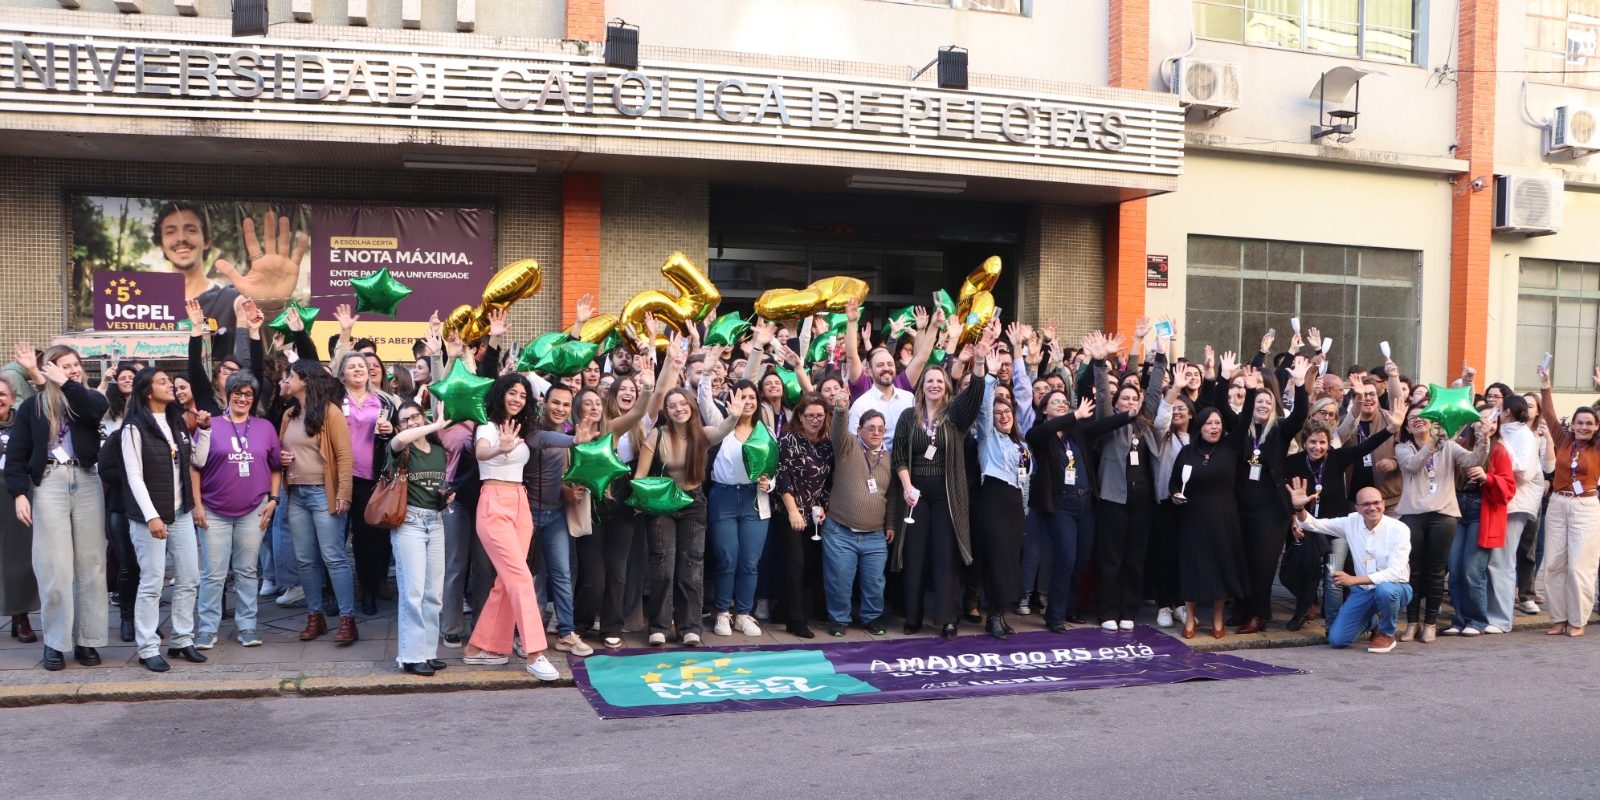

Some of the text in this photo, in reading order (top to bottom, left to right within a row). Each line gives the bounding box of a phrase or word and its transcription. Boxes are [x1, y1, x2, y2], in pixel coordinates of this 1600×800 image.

[811, 85, 881, 130] DE
[901, 92, 1127, 152] PELOTAS
[344, 250, 393, 263] NOTA
[395, 248, 474, 265] MÁXIMA.
[406, 271, 469, 279] UNIVERSIDADE
[116, 286, 130, 302] 5
[105, 303, 175, 321] UCPEL
[106, 322, 175, 330] VESTIBULAR
[871, 659, 892, 673] A
[896, 652, 1001, 671] MAIOR
[1050, 647, 1090, 664] RS
[1098, 642, 1154, 659] está
